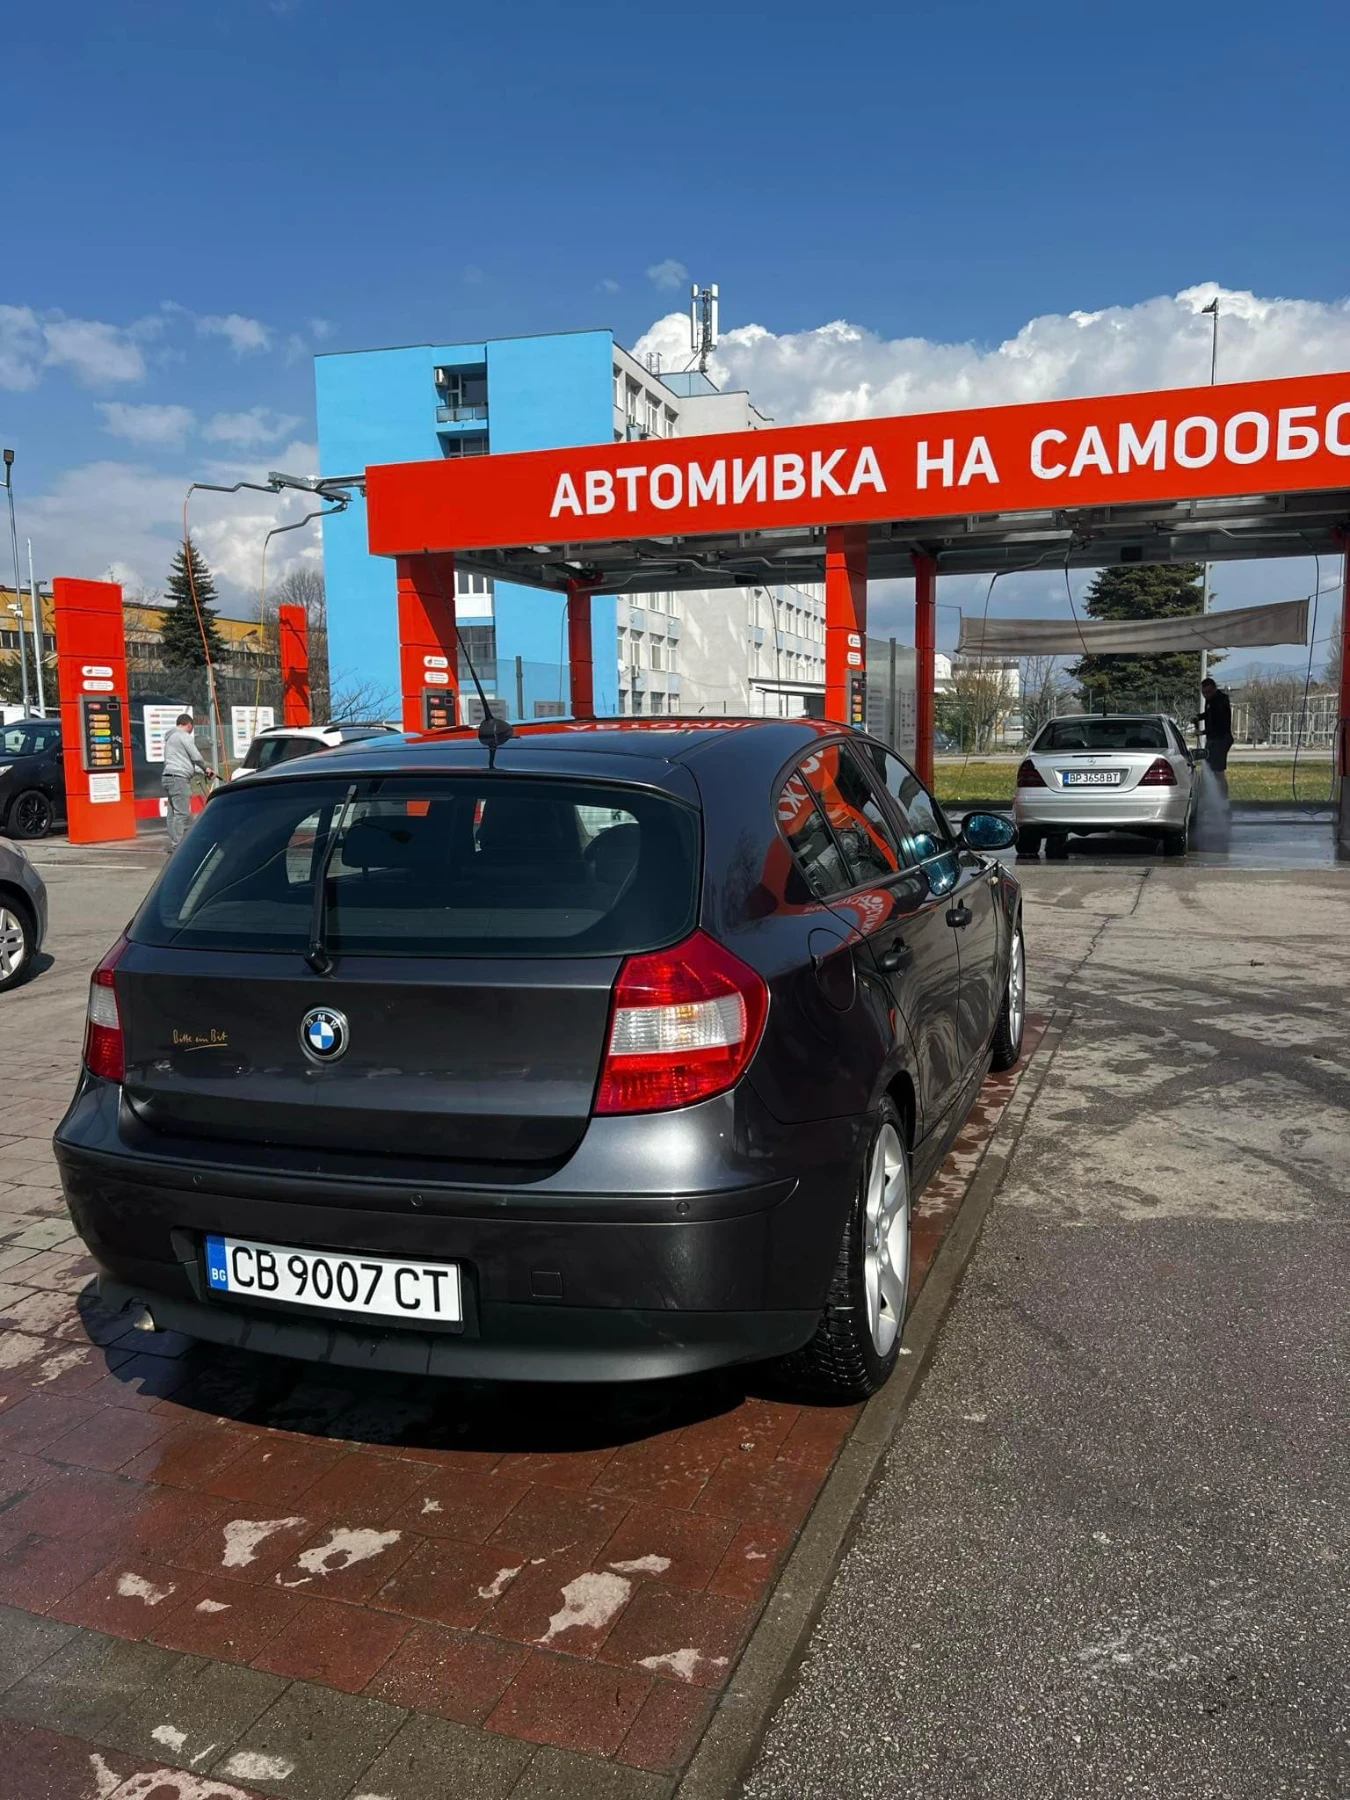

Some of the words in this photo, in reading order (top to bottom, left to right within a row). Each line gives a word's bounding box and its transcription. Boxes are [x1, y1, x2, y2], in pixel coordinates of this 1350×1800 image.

[549, 445, 888, 518] АВТОМИВКА
[916, 435, 1000, 489] НА
[172, 1029, 192, 1044] Bitte
[210, 1028, 228, 1042] Bit
[211, 1268, 227, 1282] BG
[231, 1245, 280, 1291] CB
[287, 1255, 383, 1305] 9007
[394, 1267, 449, 1312] CT
